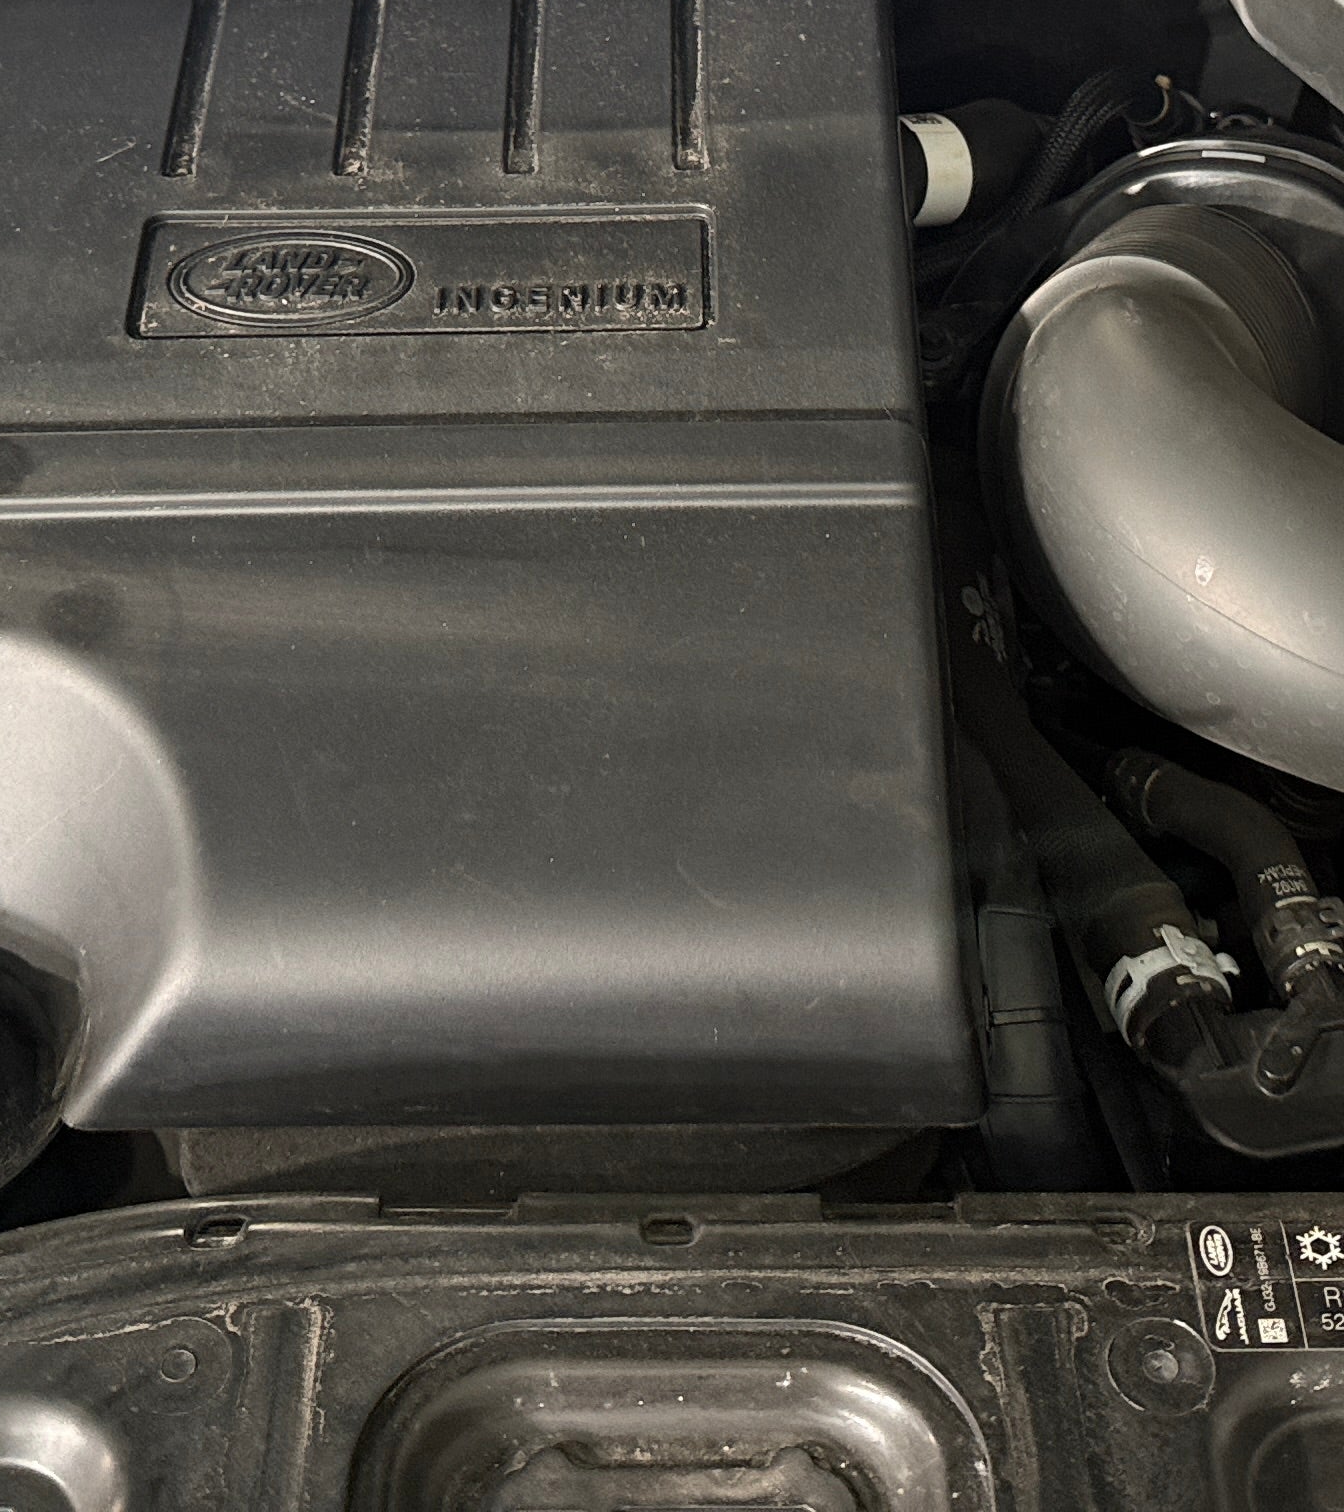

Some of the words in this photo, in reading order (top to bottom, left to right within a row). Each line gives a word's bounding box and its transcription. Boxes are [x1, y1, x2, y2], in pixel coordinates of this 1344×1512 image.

[225, 250, 364, 273] LAND
[208, 271, 370, 302] ROVER
[432, 286, 689, 316] INGENIUM
[1232, 1288, 1249, 1345] JAGUAR
